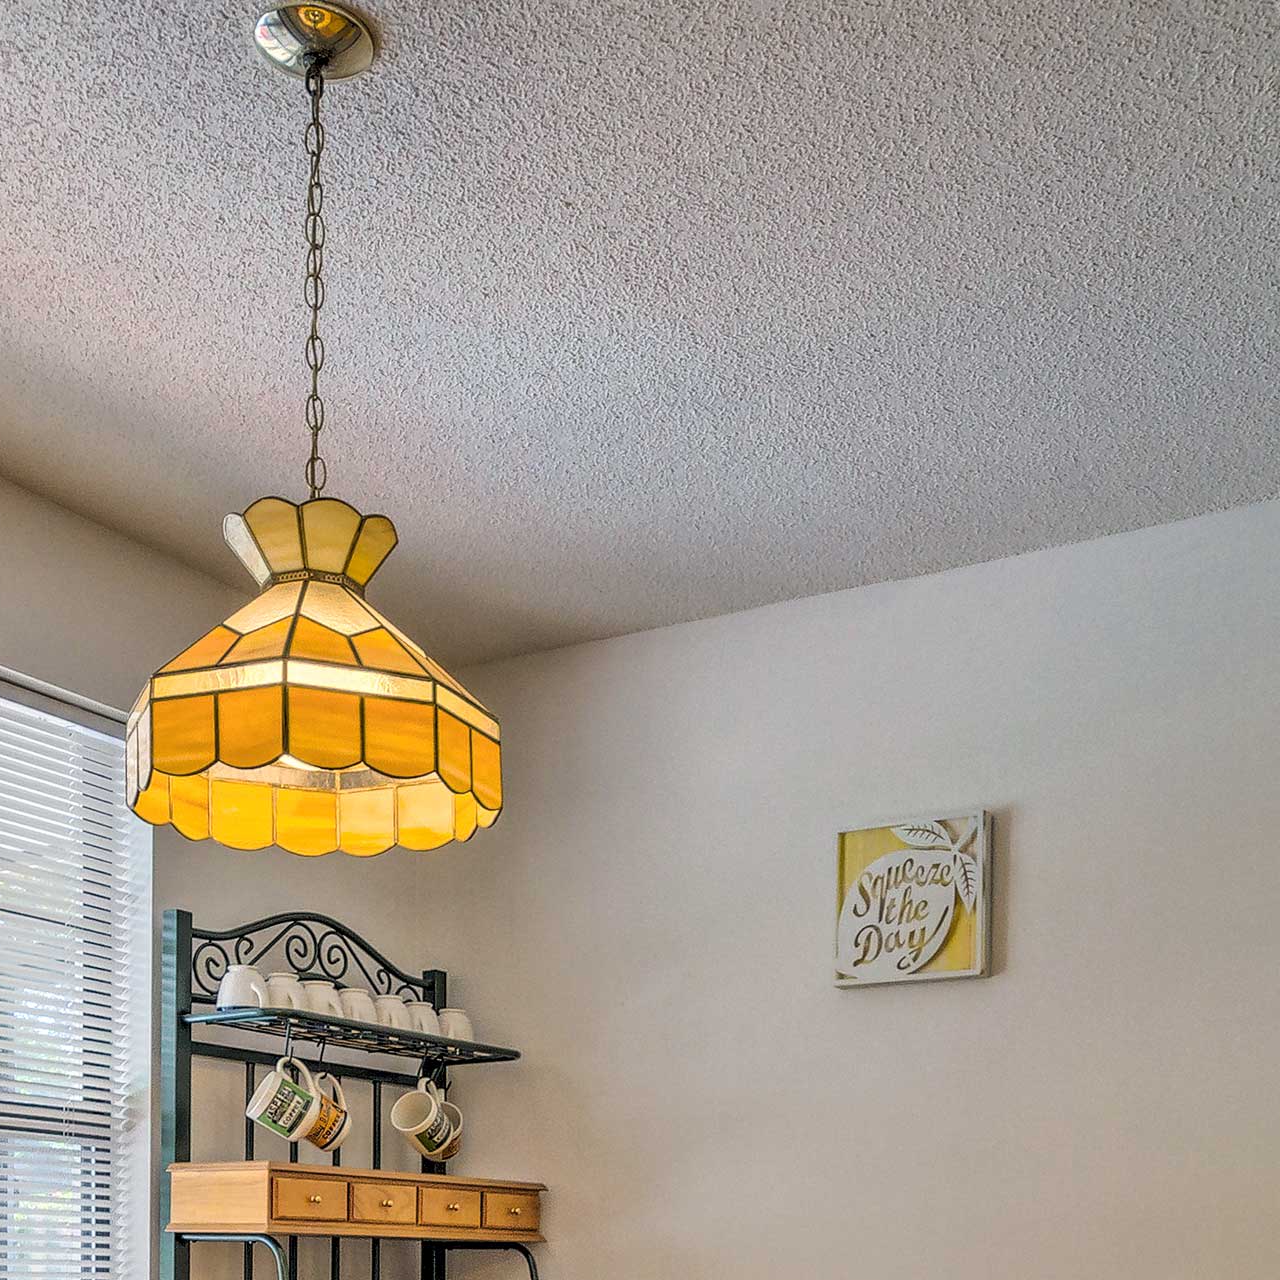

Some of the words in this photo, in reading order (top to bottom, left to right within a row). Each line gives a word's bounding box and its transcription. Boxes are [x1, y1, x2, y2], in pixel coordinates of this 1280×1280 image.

[853, 858, 953, 923] Squeeze
[885, 886, 929, 925] the
[853, 905, 949, 970] Day
